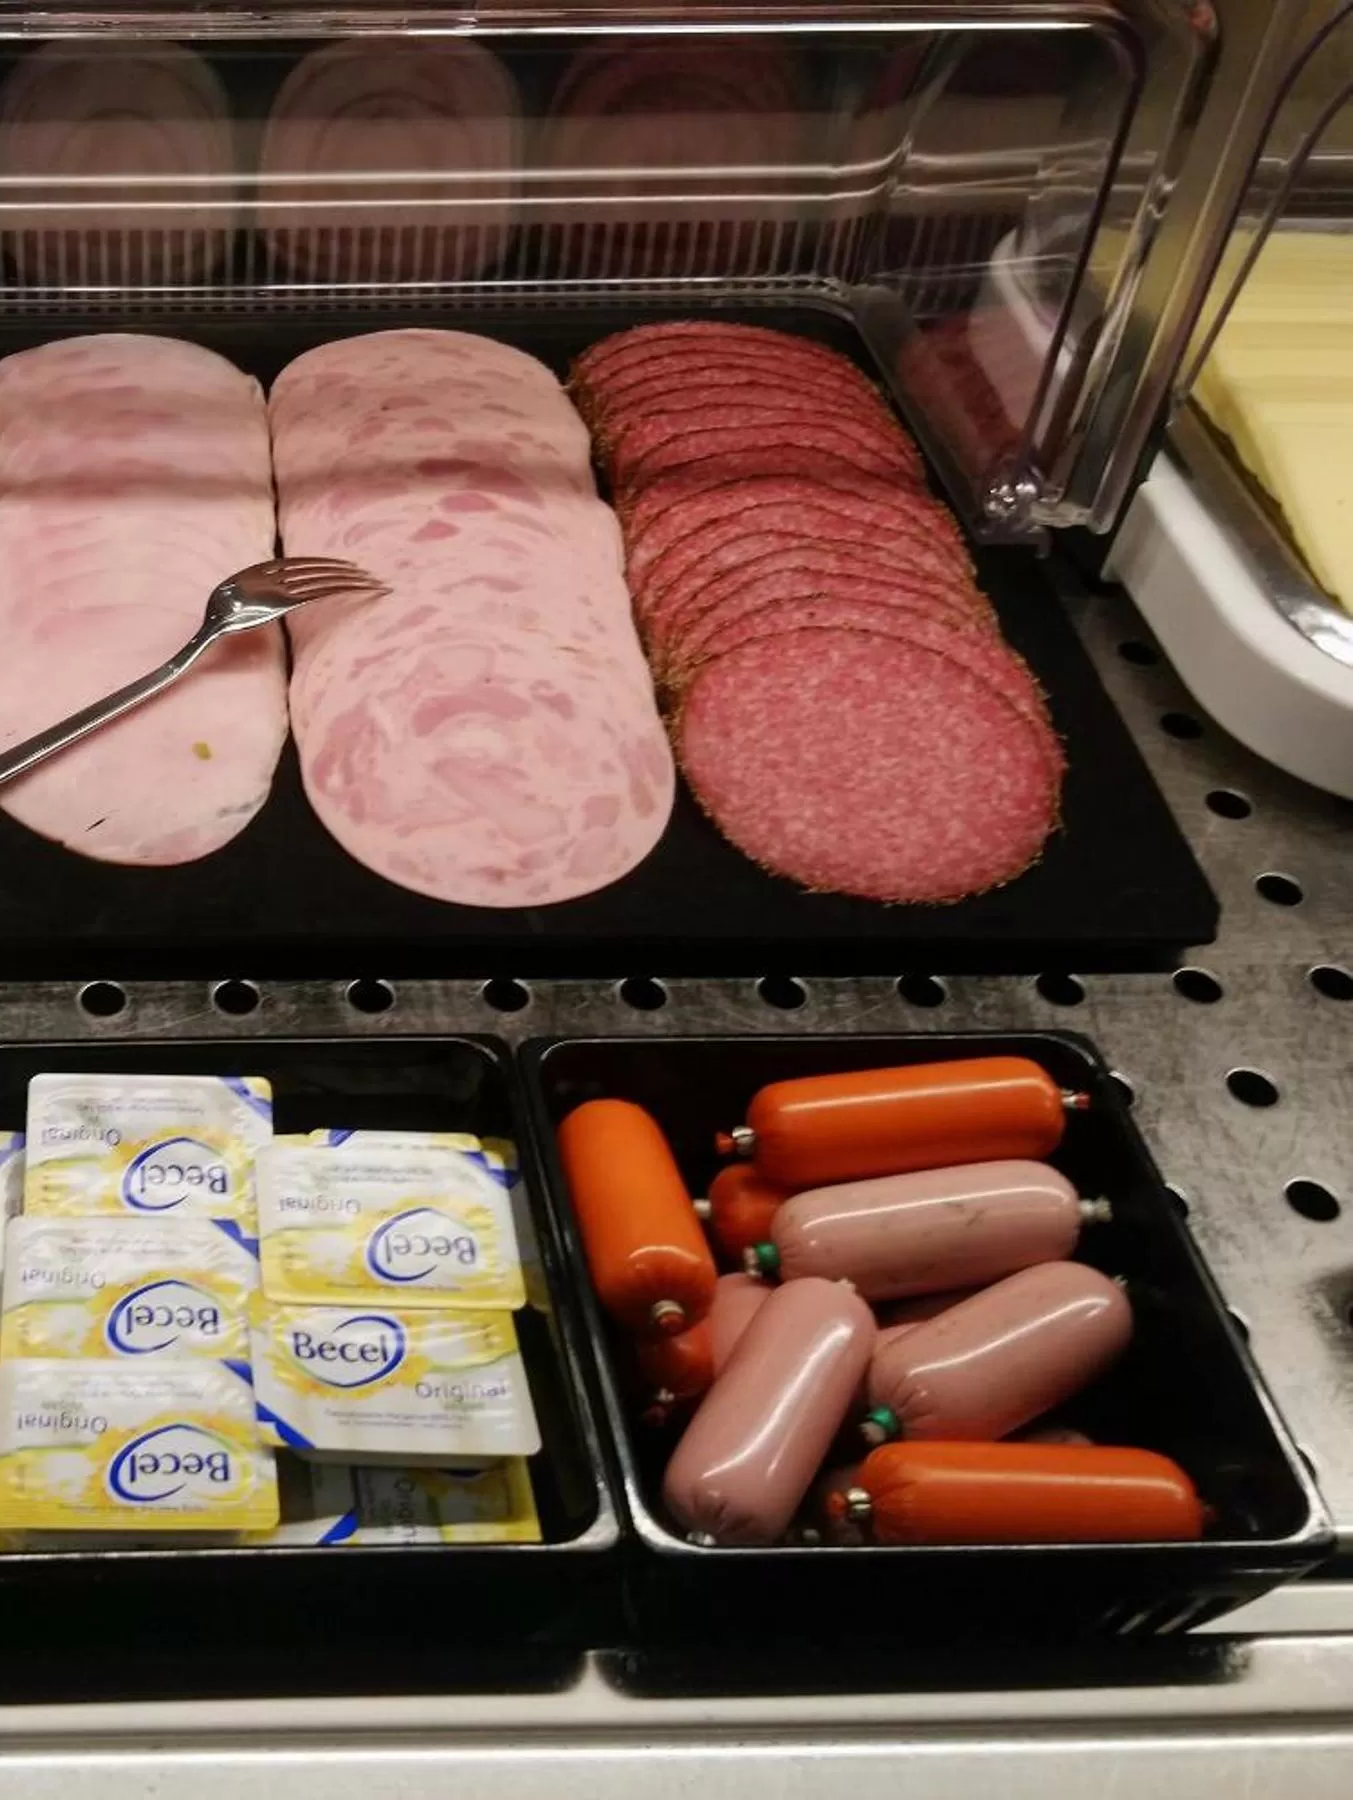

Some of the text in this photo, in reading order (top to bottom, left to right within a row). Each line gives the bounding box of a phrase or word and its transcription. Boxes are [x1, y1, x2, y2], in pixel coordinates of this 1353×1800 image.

[140, 1163, 229, 1195] Becel
[384, 1231, 477, 1265] Becel
[124, 1304, 220, 1337] Becel
[292, 1331, 389, 1364] Becel
[16, 1411, 108, 1435] Original
[127, 1451, 231, 1484] Becel
